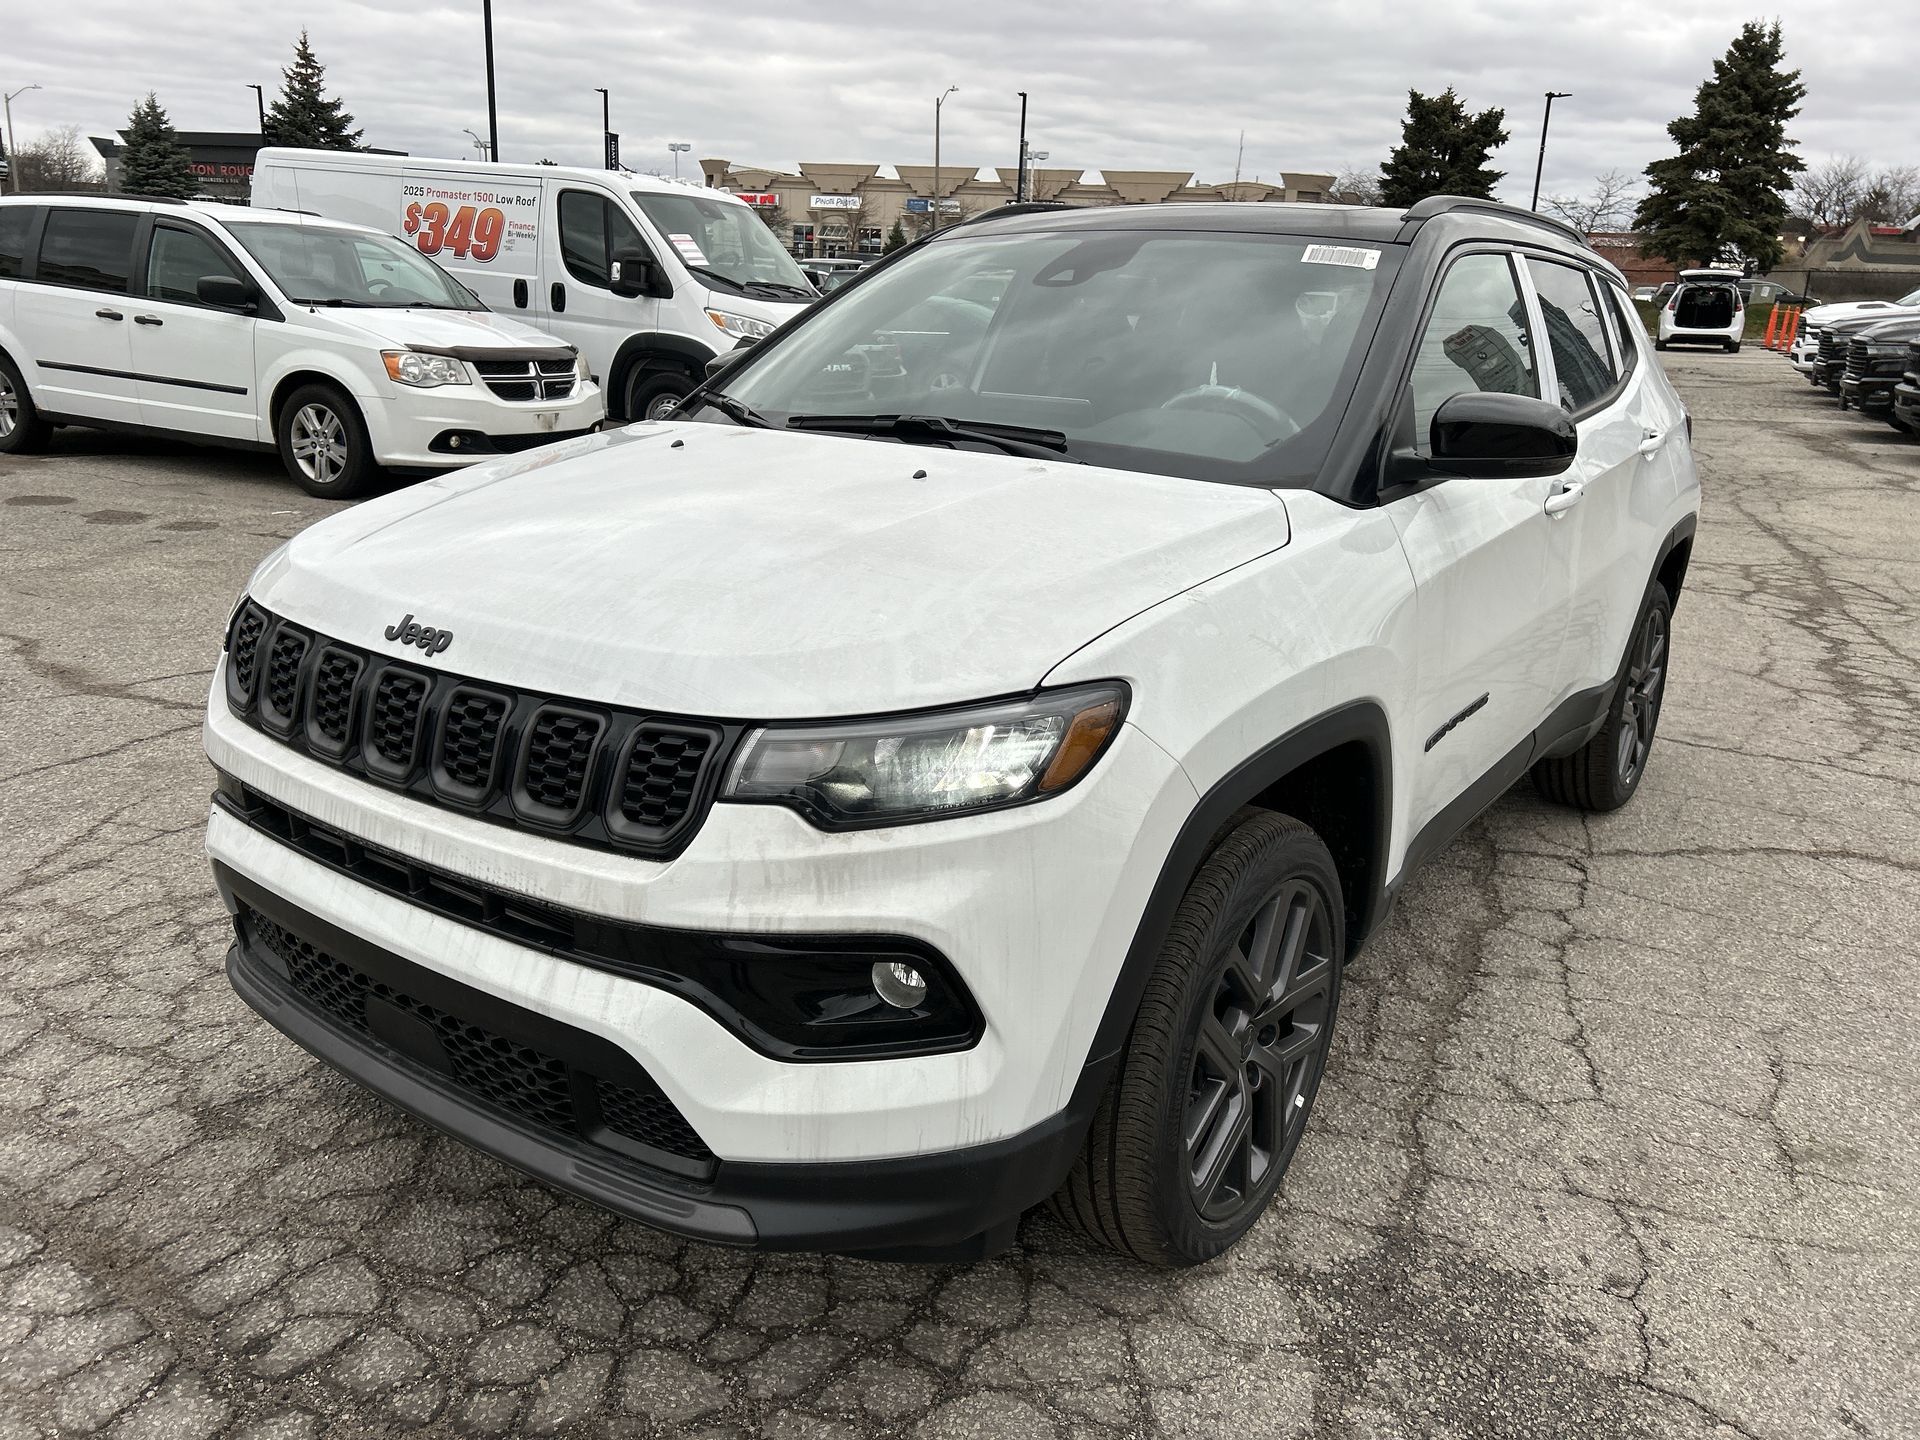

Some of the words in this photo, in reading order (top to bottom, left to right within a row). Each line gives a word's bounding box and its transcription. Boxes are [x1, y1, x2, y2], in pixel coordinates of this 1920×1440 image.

[220, 165, 254, 176] ROUG
[403, 185, 425, 197] 2025
[426, 187, 471, 201] Promaster
[473, 191, 493, 203] 1500
[495, 194, 514, 205] Low
[515, 195, 537, 207] Roof
[403, 201, 506, 263] $349
[508, 220, 536, 231] Finance
[507, 230, 537, 241] Bi-Weekly
[384, 613, 454, 658] Jeep
